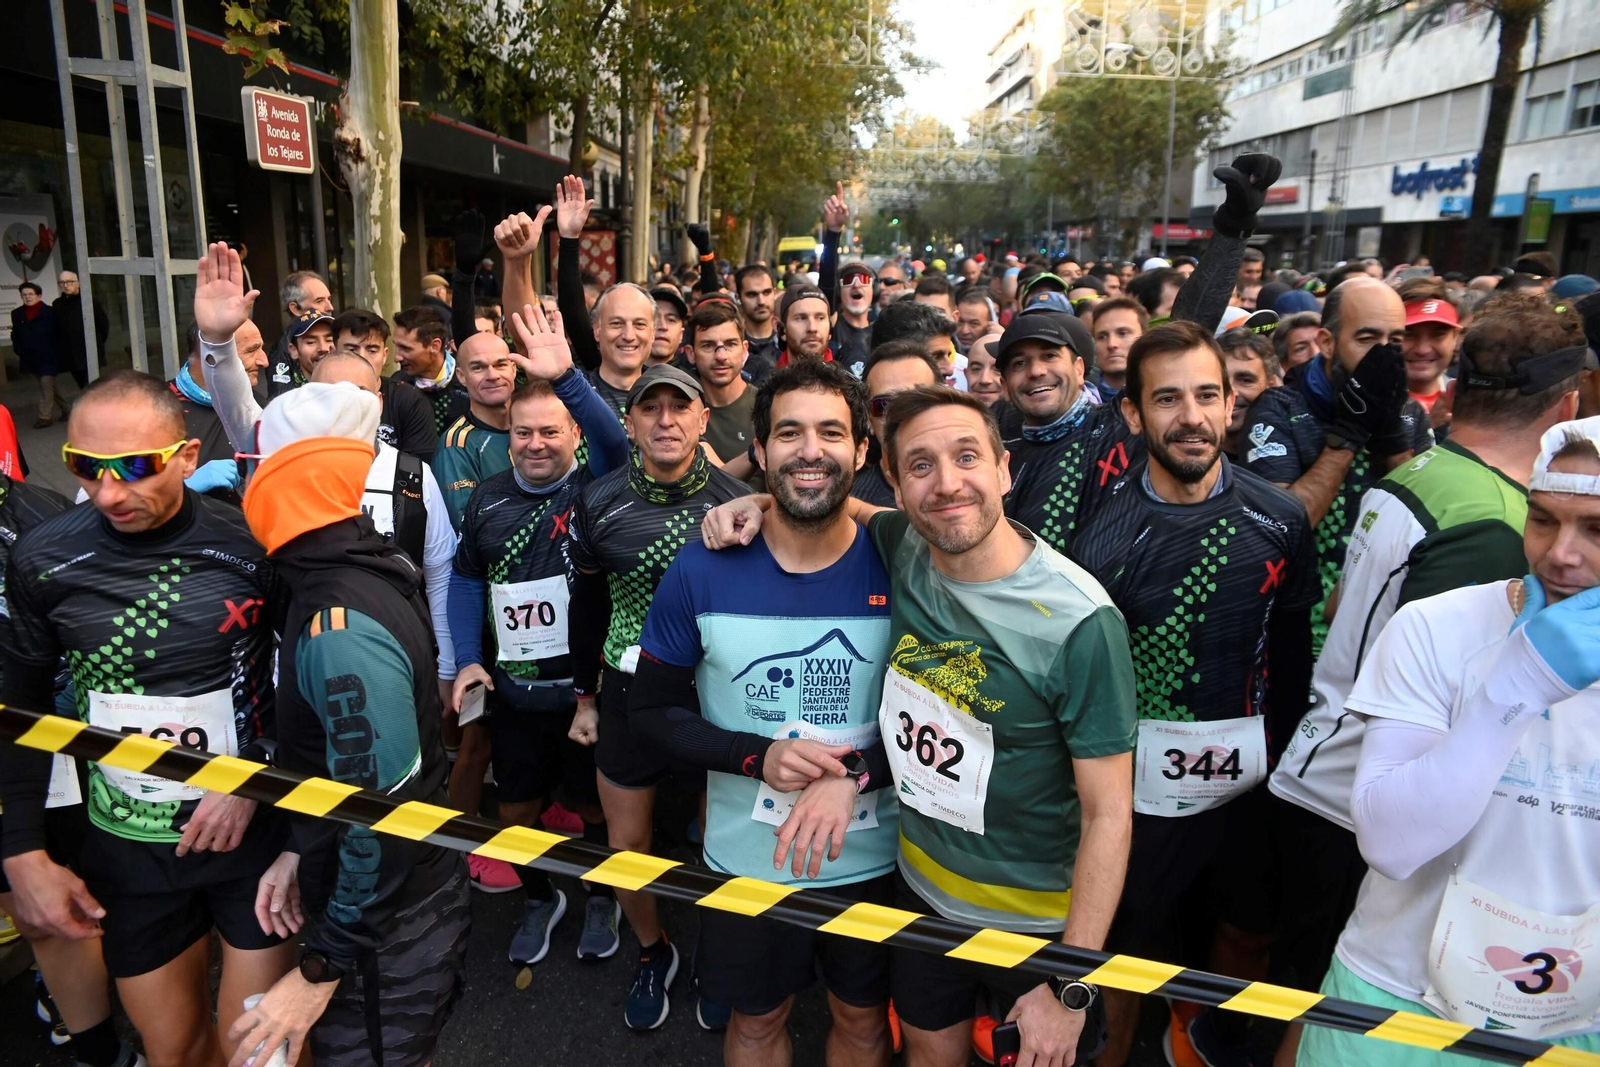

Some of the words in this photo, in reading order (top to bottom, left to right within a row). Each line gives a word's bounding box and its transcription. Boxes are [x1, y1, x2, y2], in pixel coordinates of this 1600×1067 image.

[271, 106, 299, 123] Avenida
[266, 124, 290, 140] Ronda
[292, 128, 300, 142] de
[266, 143, 278, 157] los
[280, 146, 304, 162] Tejares
[214, 550, 257, 572] IMDECO
[504, 600, 556, 631] 370
[804, 658, 853, 675] XXXIV
[803, 676, 851, 687] SUBIDA
[745, 683, 780, 700] CAE
[802, 687, 850, 696] PEDESTRE
[802, 696, 850, 704] SANTUARIO
[900, 684, 921, 701] SUBIDA
[928, 702, 940, 712] LAS
[114, 702, 146, 711] SUBIDA
[802, 712, 848, 725] SIERRA
[802, 730, 831, 745] SUBIDA
[896, 711, 965, 782] 362
[1162, 748, 1243, 781] 344
[902, 773, 910, 782] LUIS
[911, 778, 926, 790] GARCIA
[926, 788, 936, 796] DIEZ
[1517, 794, 1540, 808] edp
[938, 804, 966, 820] IMDECO
[1470, 896, 1482, 907] XI
[1484, 902, 1529, 929] SUBIDA
[1532, 924, 1542, 932] A
[1544, 926, 1568, 936] LAS
[1514, 952, 1557, 995] 3
[1492, 1000, 1528, 1012] dona
[1494, 991, 1543, 1005] Regala
[1547, 994, 1576, 1004] VIDA
[1465, 1000, 1491, 1014] JAVIER
[1492, 1010, 1540, 1020] PONFERRADA
